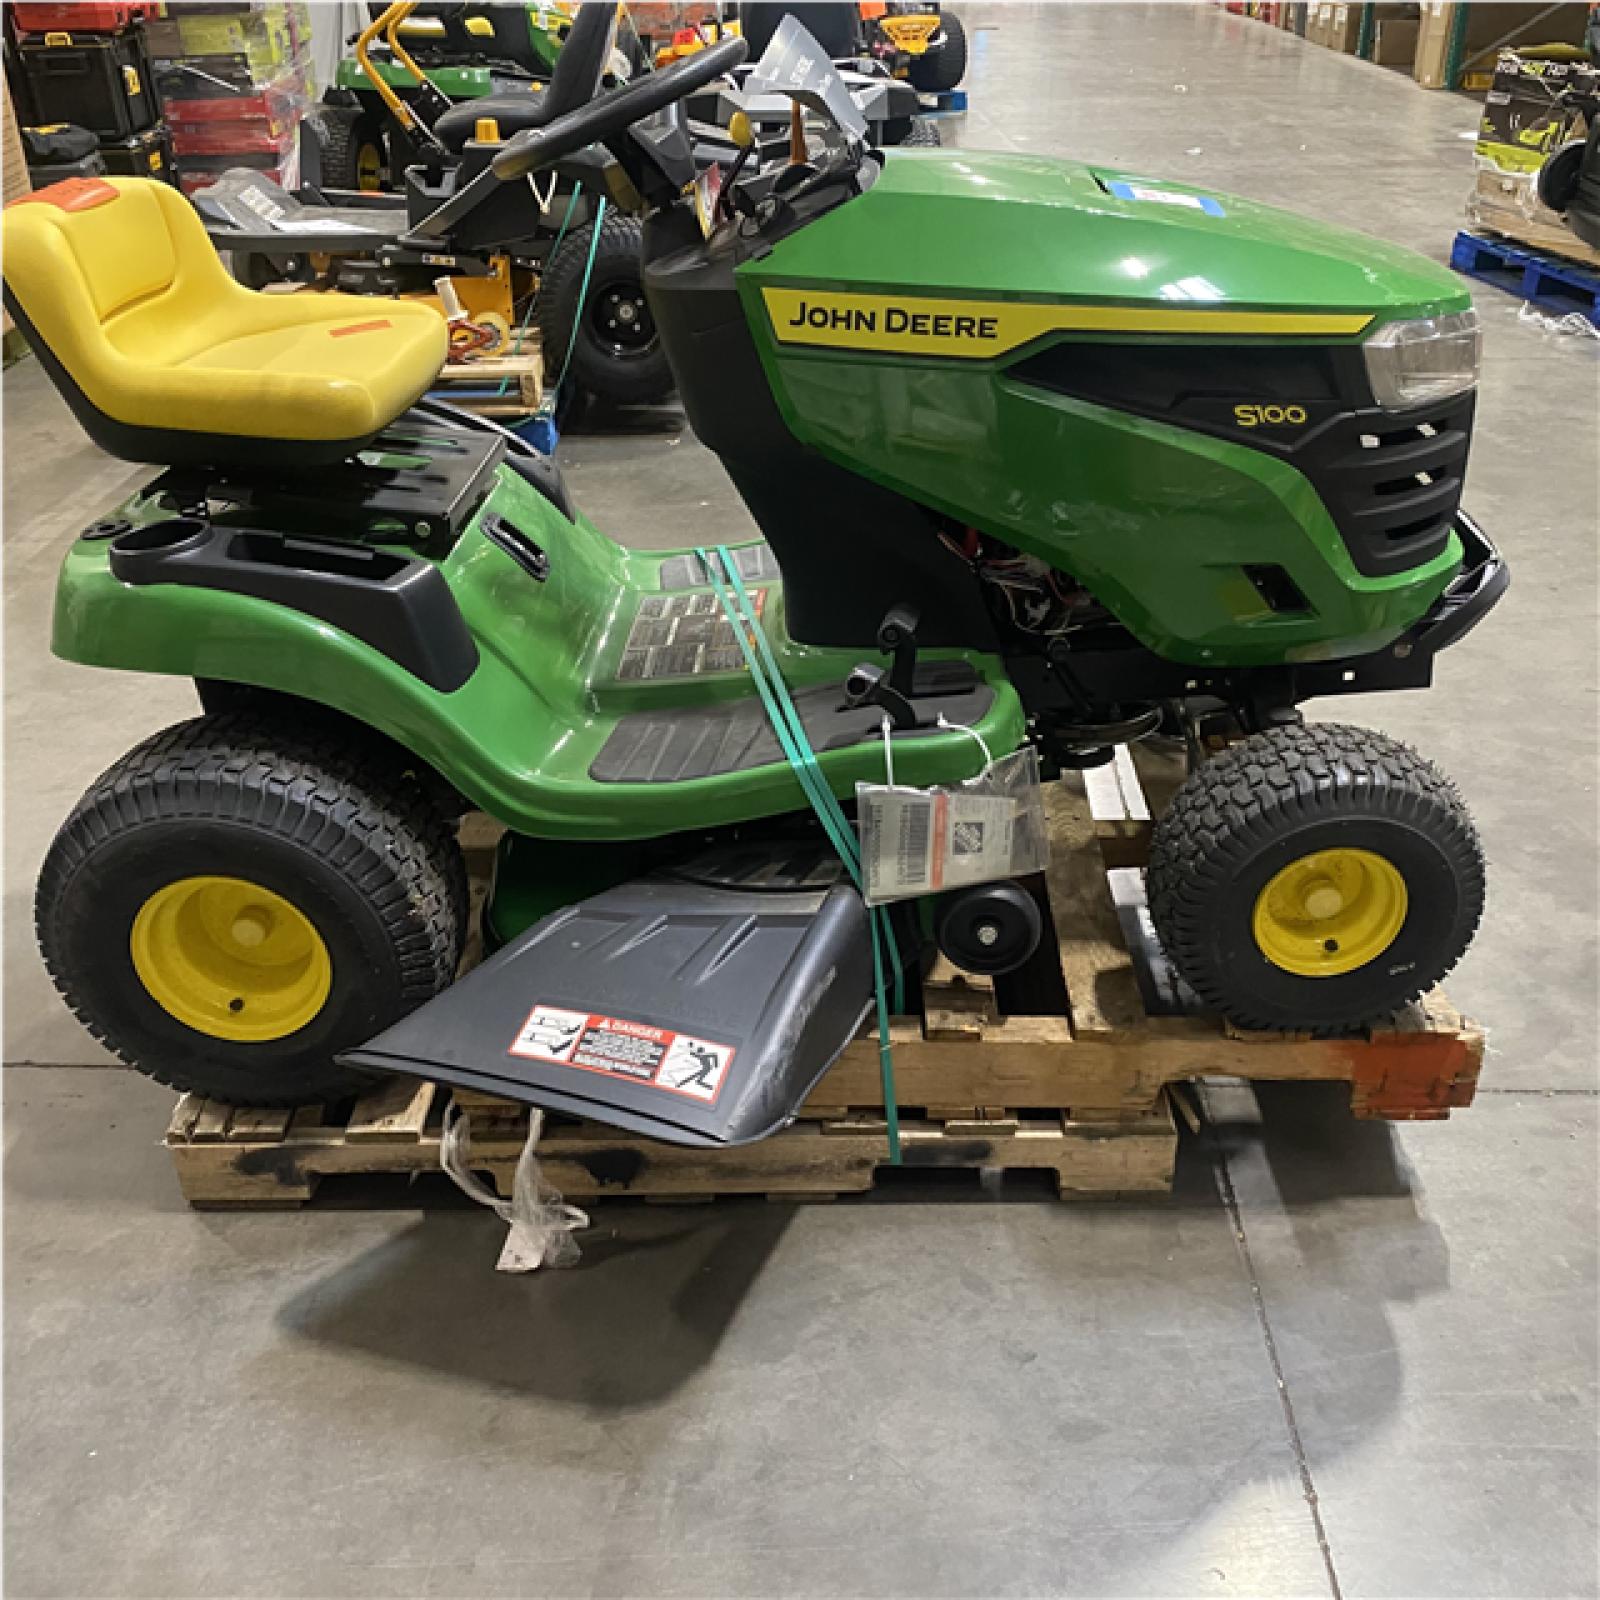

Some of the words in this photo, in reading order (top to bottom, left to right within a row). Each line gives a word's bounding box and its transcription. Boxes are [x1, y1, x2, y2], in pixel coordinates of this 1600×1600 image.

[789, 302, 876, 332] JOHN
[884, 307, 999, 339] DEERE
[1234, 404, 1307, 426] S100
